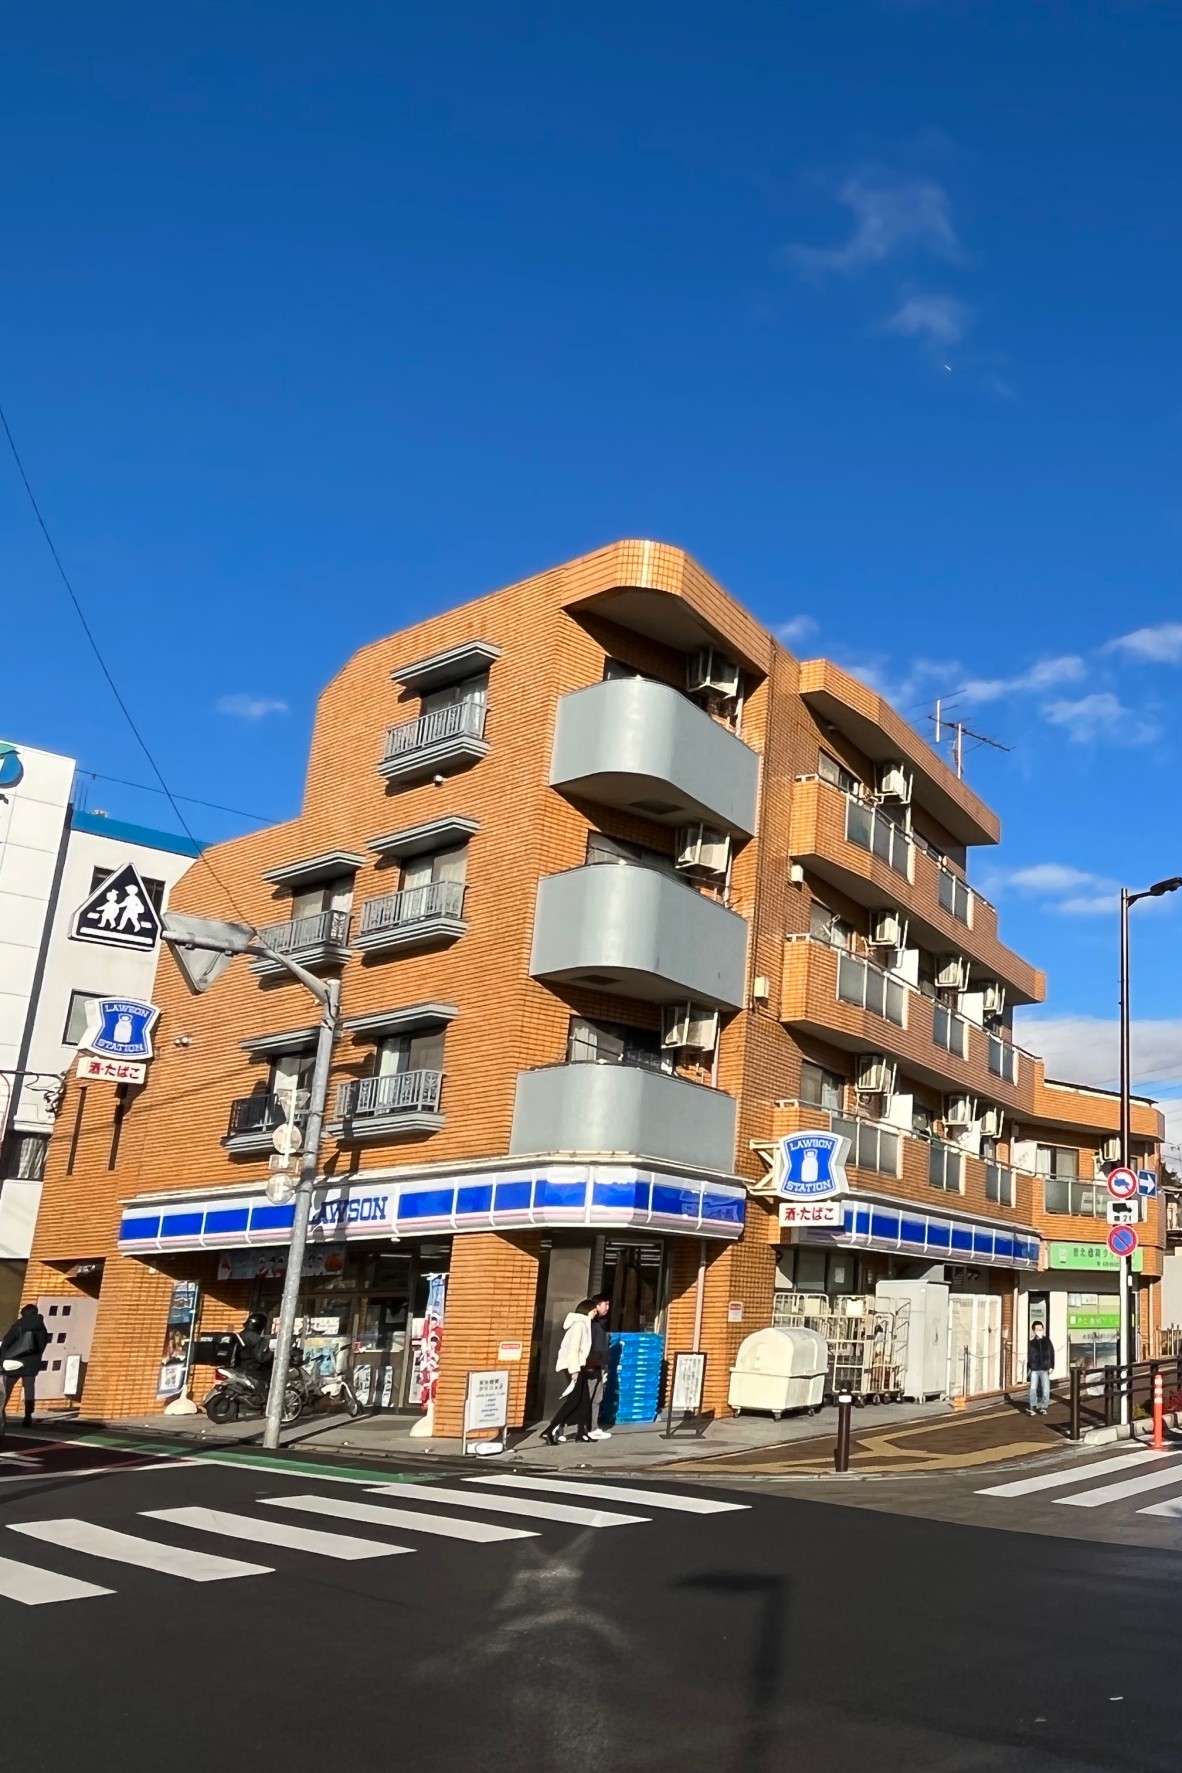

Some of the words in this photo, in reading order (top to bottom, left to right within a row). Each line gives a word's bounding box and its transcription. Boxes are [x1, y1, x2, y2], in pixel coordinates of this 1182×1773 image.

[104, 1004, 149, 1018] LAWSON
[97, 1038, 145, 1052] STATION
[789, 1138, 833, 1151] LAWSON
[786, 1178, 832, 1193] STATION
[309, 1196, 389, 1225] AWSON
